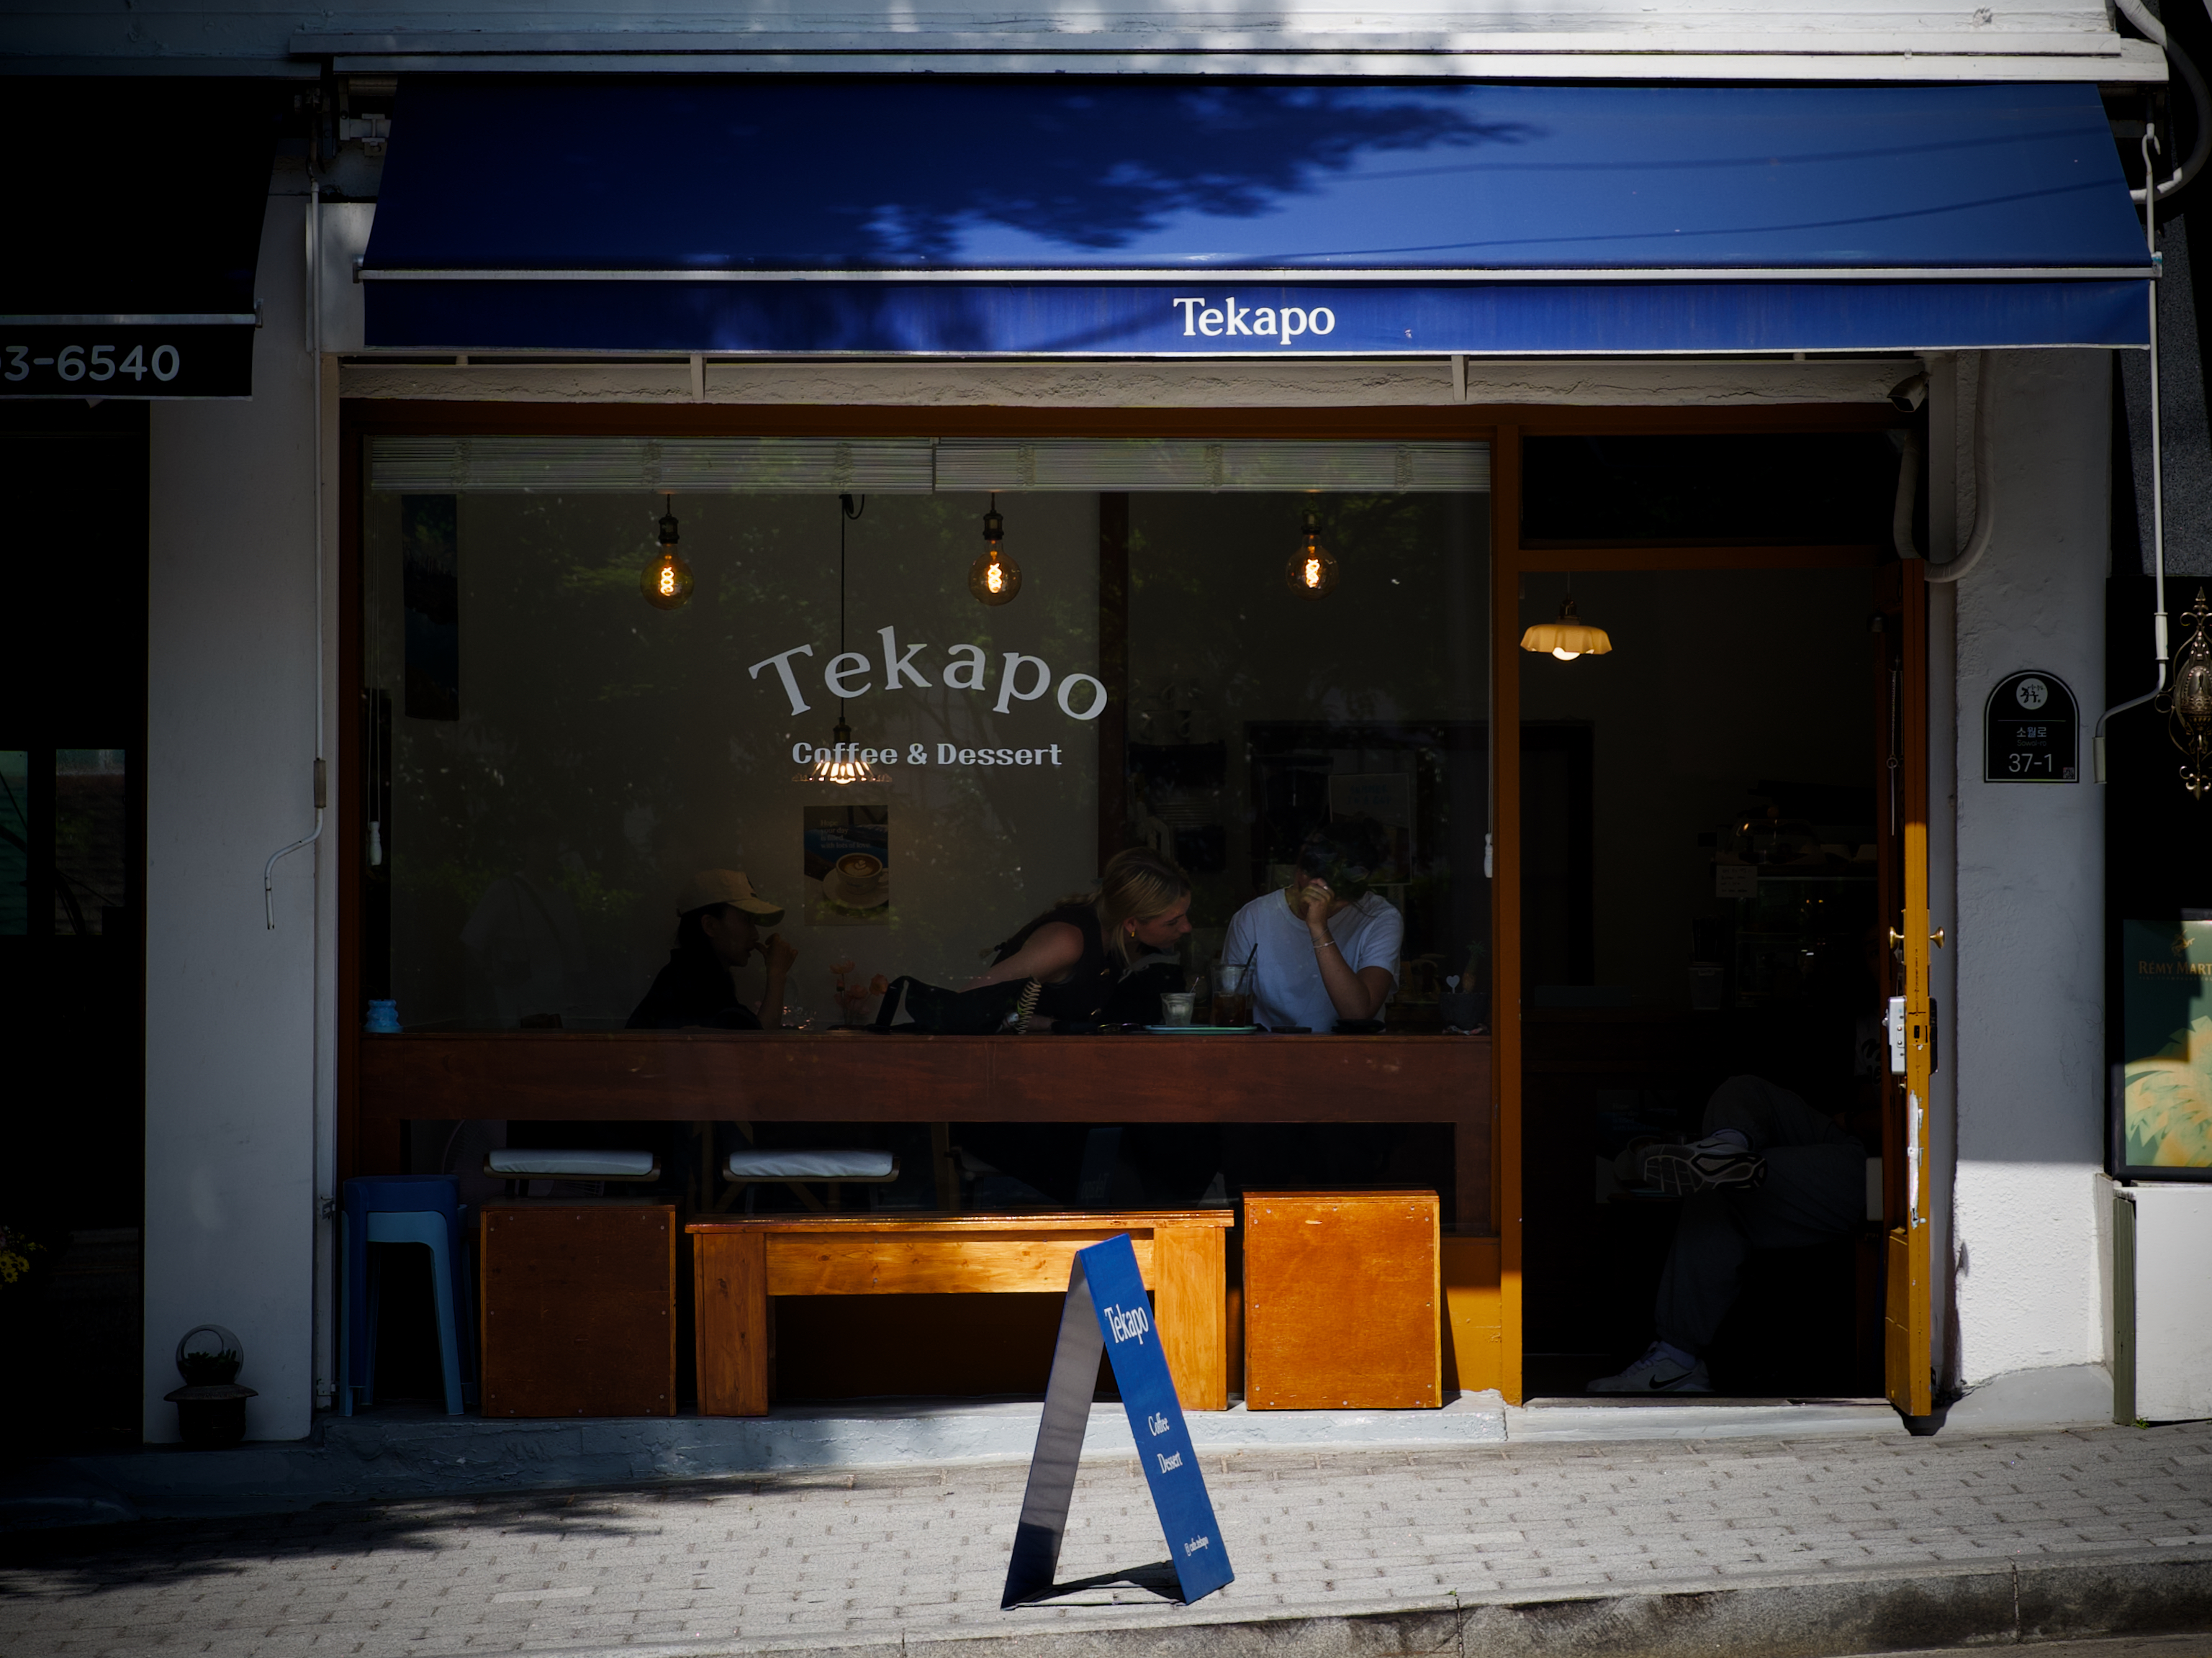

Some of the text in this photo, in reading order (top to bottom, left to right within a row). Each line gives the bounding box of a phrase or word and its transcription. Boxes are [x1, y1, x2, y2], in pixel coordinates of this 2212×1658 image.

[1173, 296, 1335, 345] Tekapo
[0, 344, 180, 381] 3-6540
[748, 625, 1109, 721] Tekapo
[2016, 726, 2047, 738] 소월로
[792, 742, 1062, 766] Coffee & Dessert
[2008, 753, 2052, 773] 37-1
[1103, 1303, 1149, 1345] Tekapo
[1148, 1412, 1170, 1436] Coffee
[1157, 1451, 1183, 1474] Dessert
